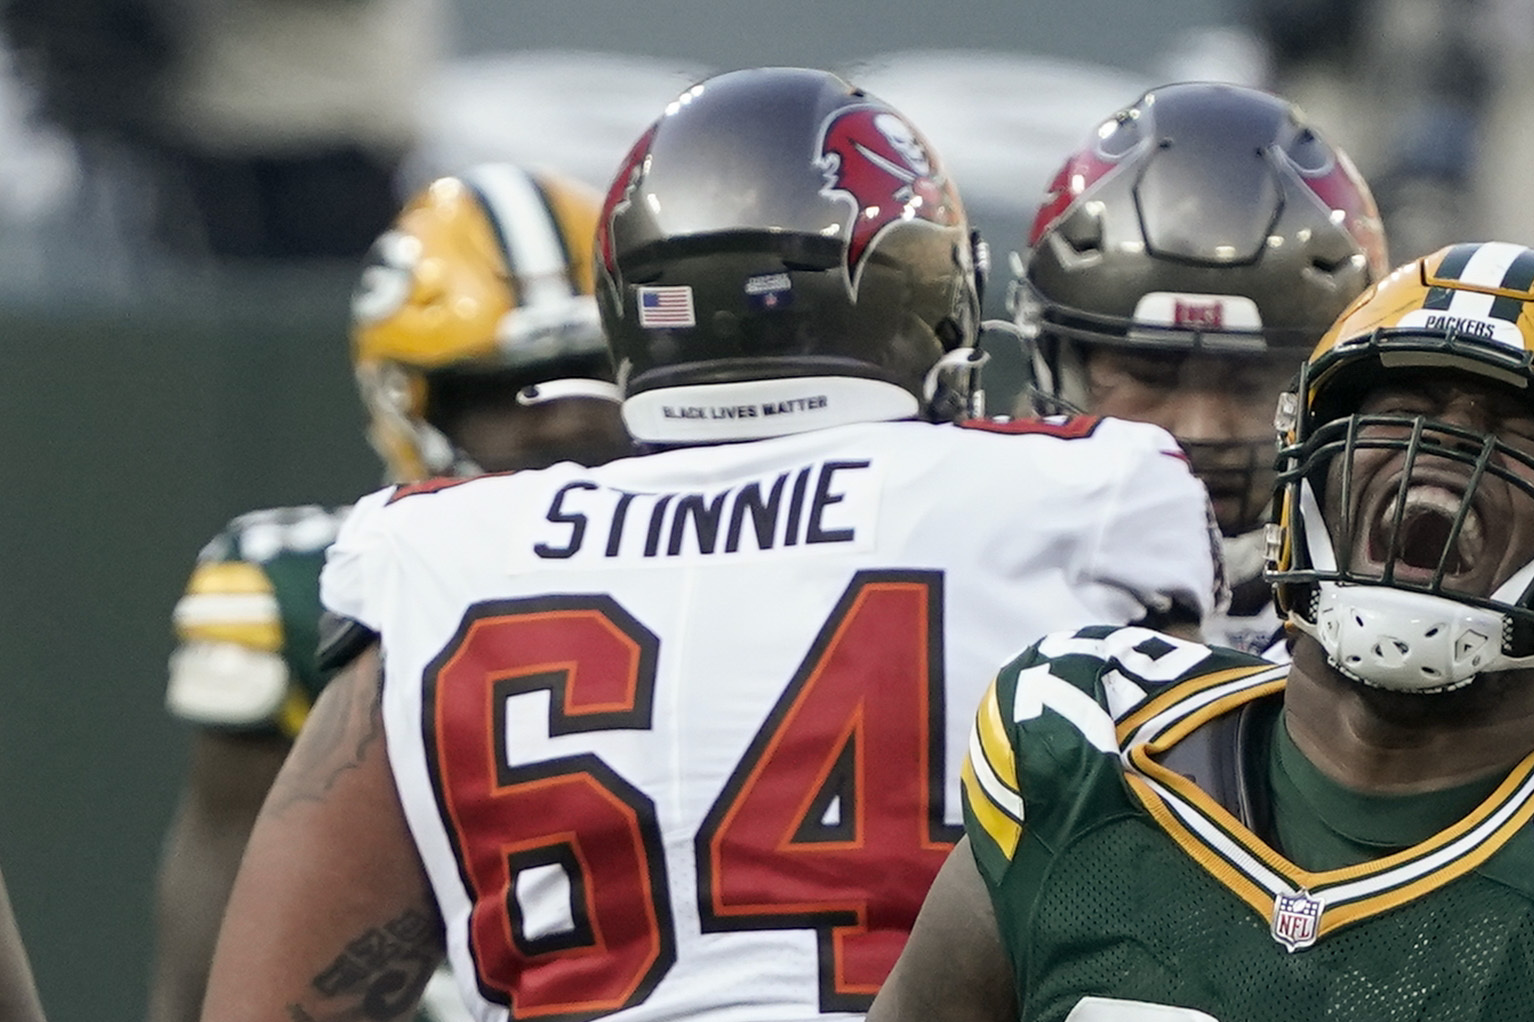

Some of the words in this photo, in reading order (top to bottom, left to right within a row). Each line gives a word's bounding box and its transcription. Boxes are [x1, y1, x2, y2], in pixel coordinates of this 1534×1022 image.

[1425, 315, 1496, 340] PACKERS
[662, 405, 708, 420] BLACK
[711, 404, 758, 419] LIVES
[763, 394, 829, 416] MATTER
[533, 459, 873, 560] STINNIE
[1278, 912, 1312, 939] NFL
